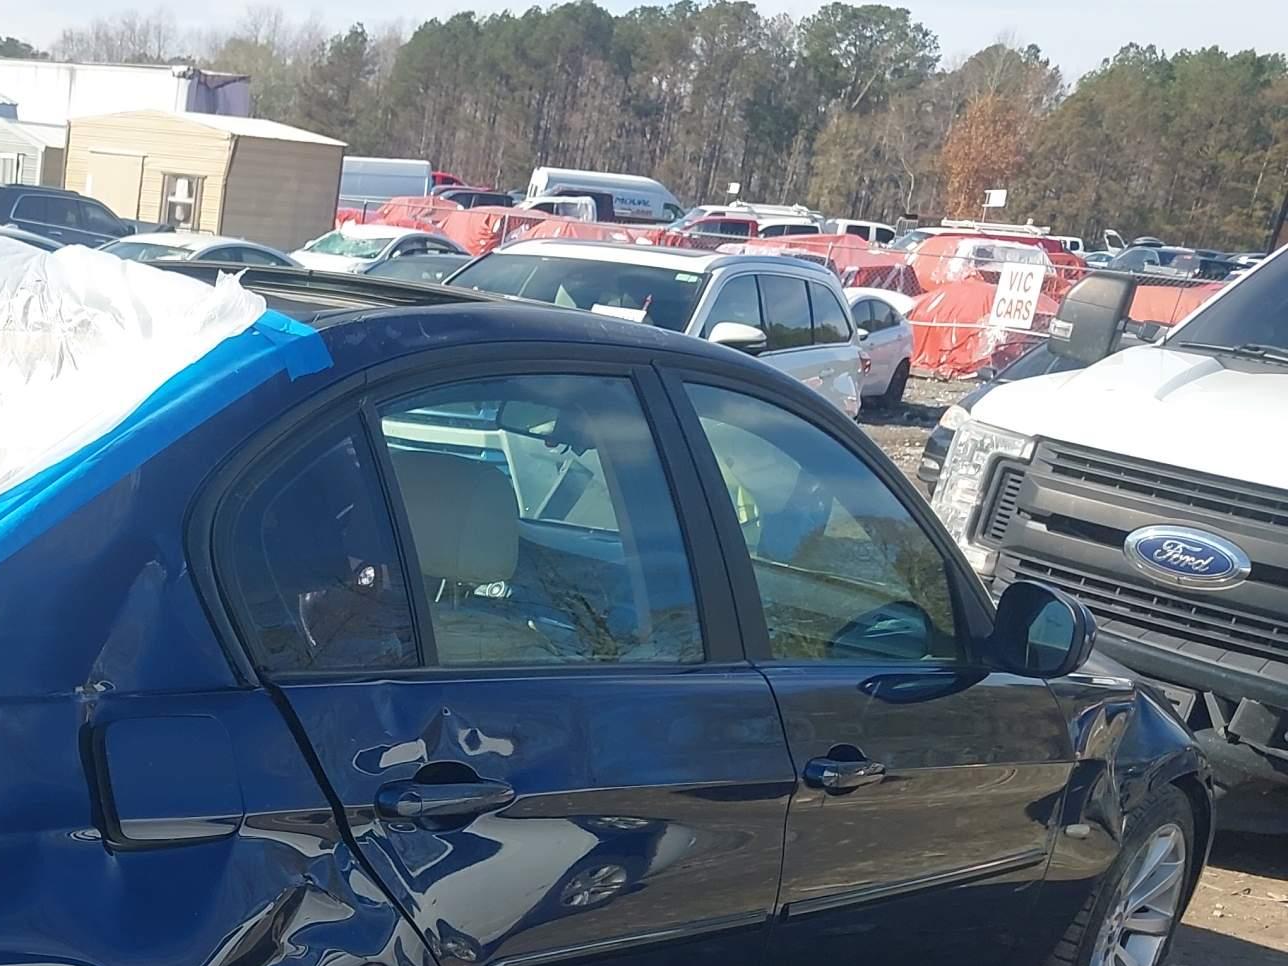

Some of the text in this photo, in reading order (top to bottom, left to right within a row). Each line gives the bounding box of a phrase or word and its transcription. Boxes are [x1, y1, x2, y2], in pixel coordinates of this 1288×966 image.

[1009, 269, 1034, 292] VIC
[995, 297, 1033, 320] CARS
[1152, 540, 1215, 572] Ford
